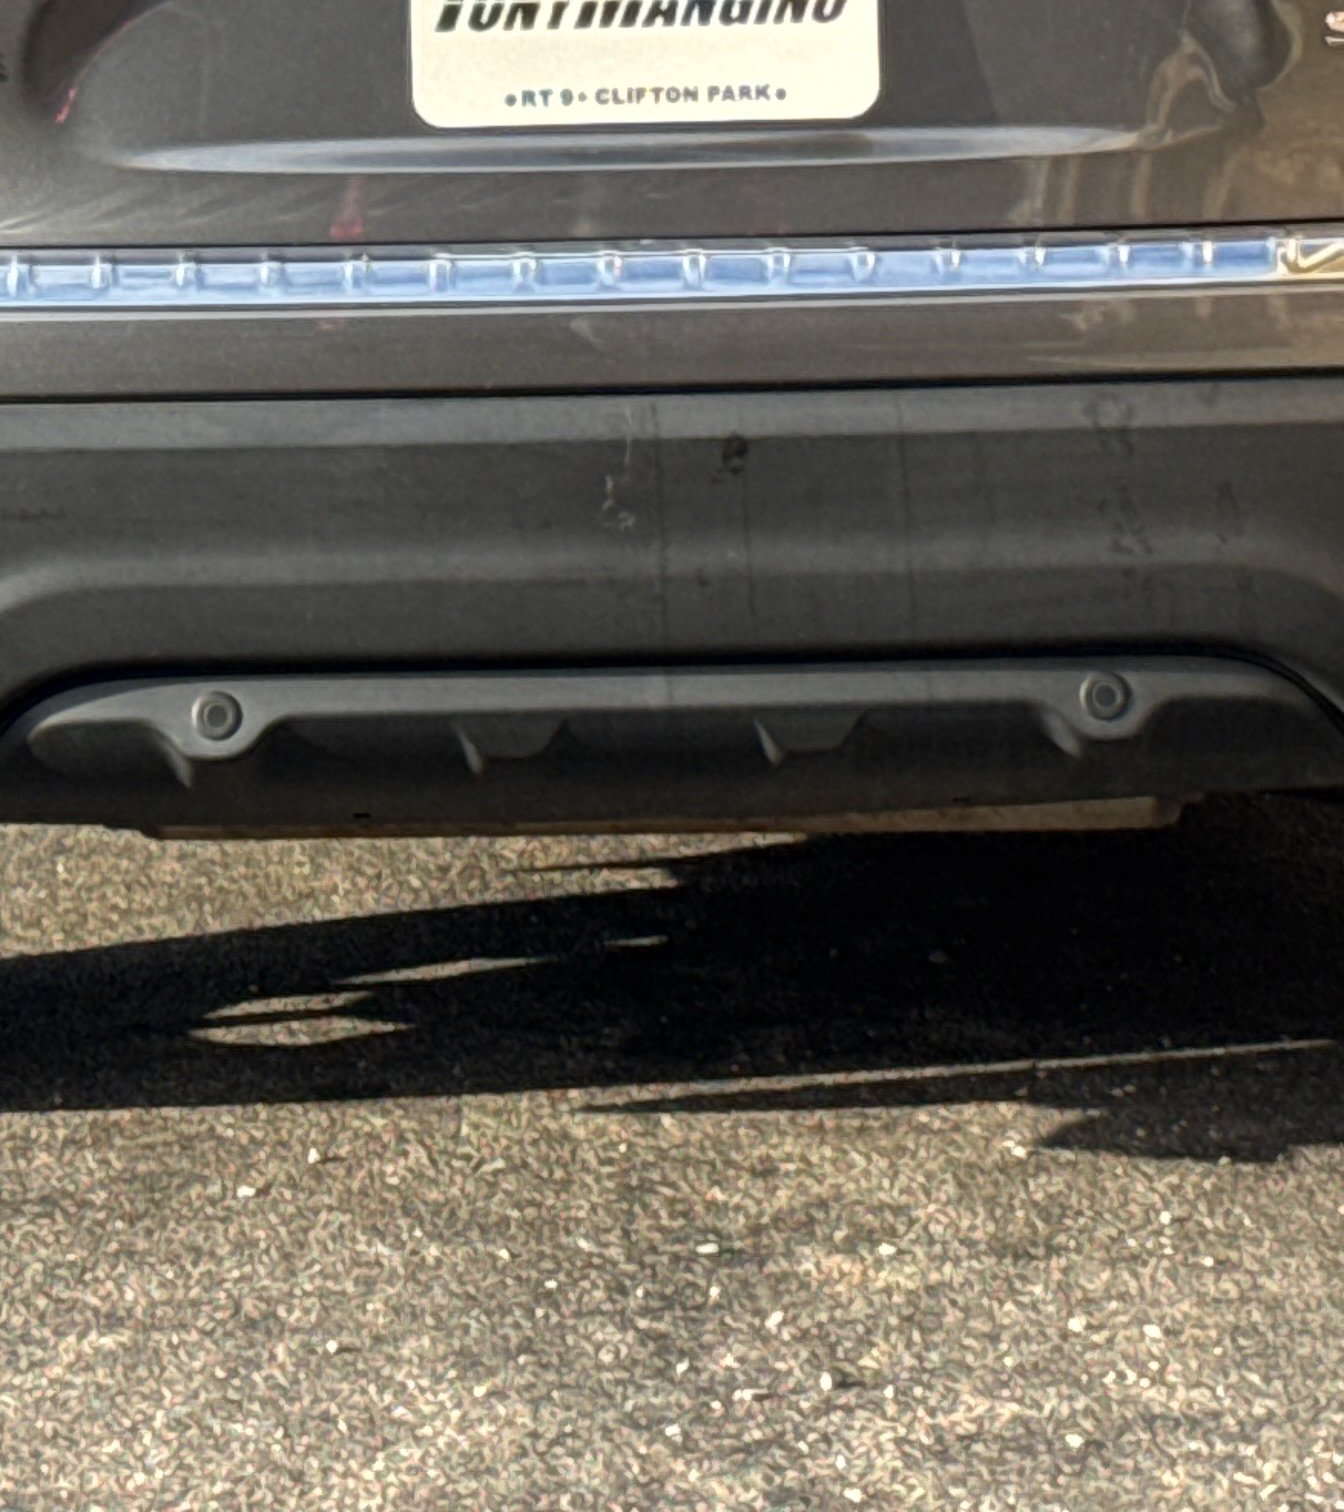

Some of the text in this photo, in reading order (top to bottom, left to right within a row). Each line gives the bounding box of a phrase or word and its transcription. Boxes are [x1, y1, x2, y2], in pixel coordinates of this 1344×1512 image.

[521, 89, 554, 108] RT
[594, 86, 699, 106] CLIFTON
[706, 84, 771, 103] PARK
